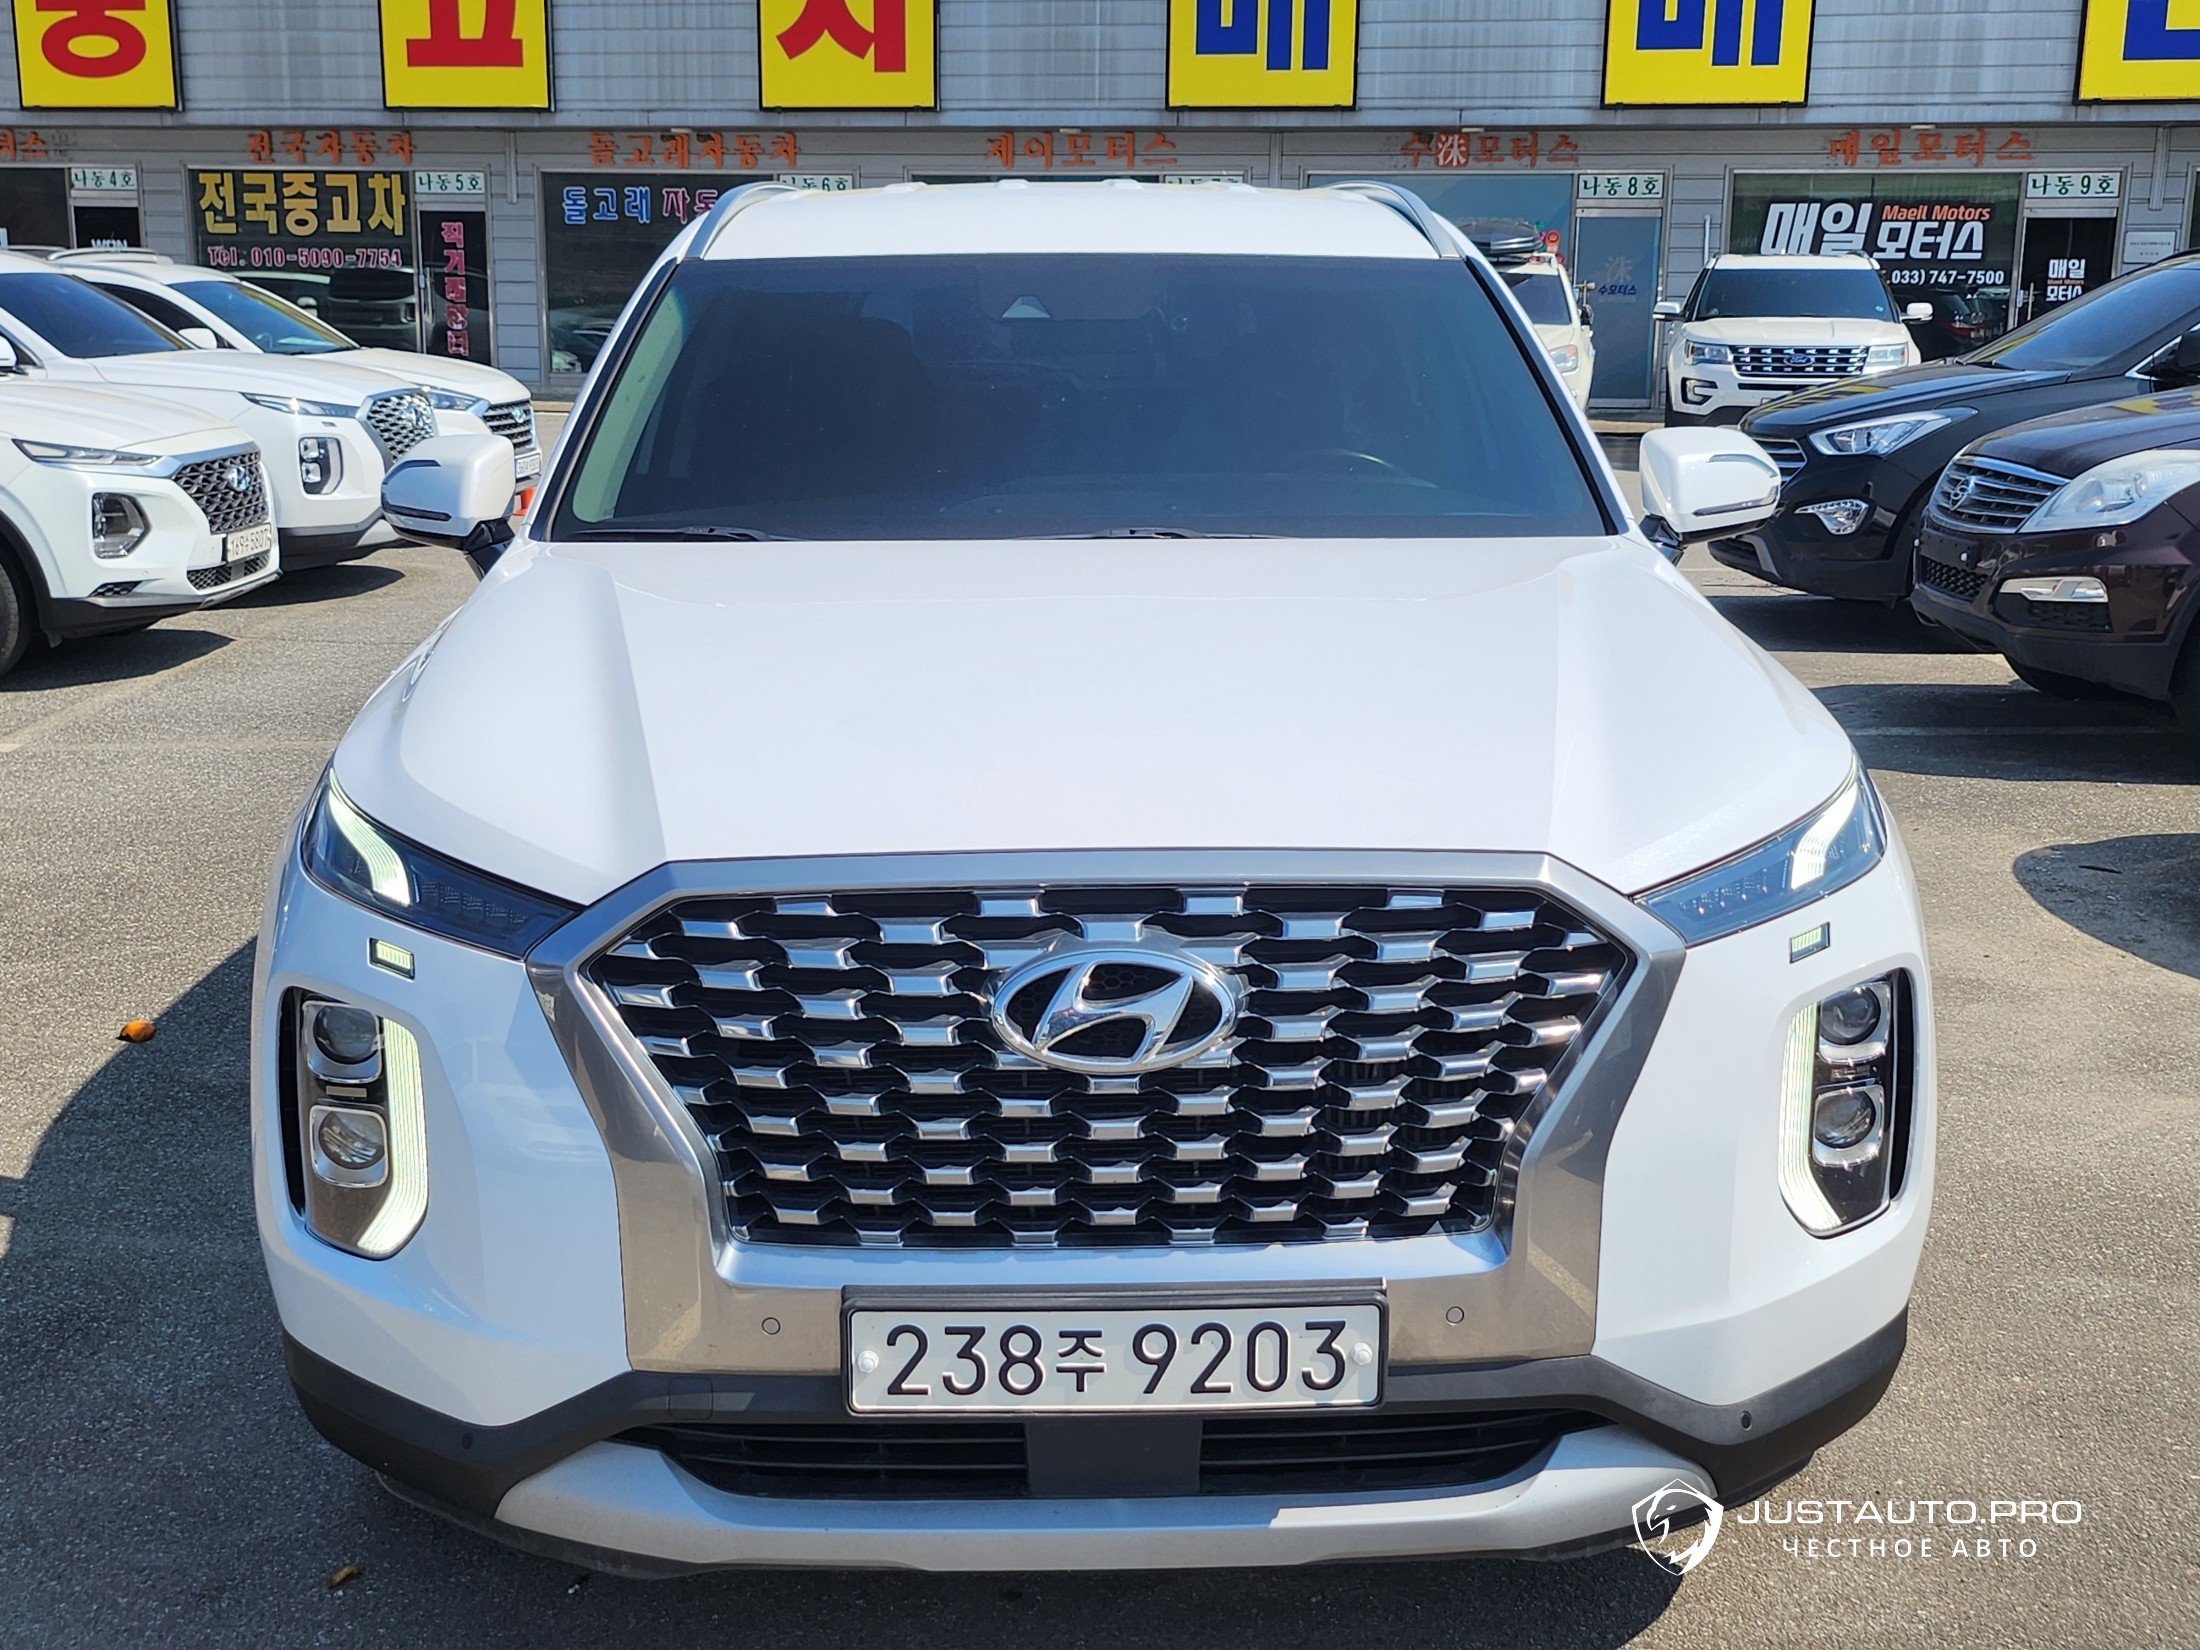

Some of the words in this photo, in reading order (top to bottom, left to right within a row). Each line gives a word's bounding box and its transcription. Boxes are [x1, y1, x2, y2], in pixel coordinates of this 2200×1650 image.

[246, 130, 416, 165] 전국자동차
[588, 131, 800, 168] 돌고래자동차
[985, 131, 1178, 169] 제이모터스
[1828, 129, 2033, 167] 매일모터스
[198, 172, 406, 236] 전국중고차
[562, 186, 650, 224] 돌고래
[1882, 205, 1928, 220] Maeil
[1932, 205, 1991, 220] Motors
[1760, 202, 1873, 255] 매일
[1873, 220, 1984, 260] 모터스
[208, 247, 246, 267] Tel.
[251, 247, 403, 268] 010-5090-7754
[2048, 259, 2086, 279] 매일
[1598, 284, 1637, 297] 수모터스
[1929, 270, 2005, 285] 747-7500
[886, 1323, 1106, 1396] 238주
[1132, 1319, 1347, 1394] 9203
